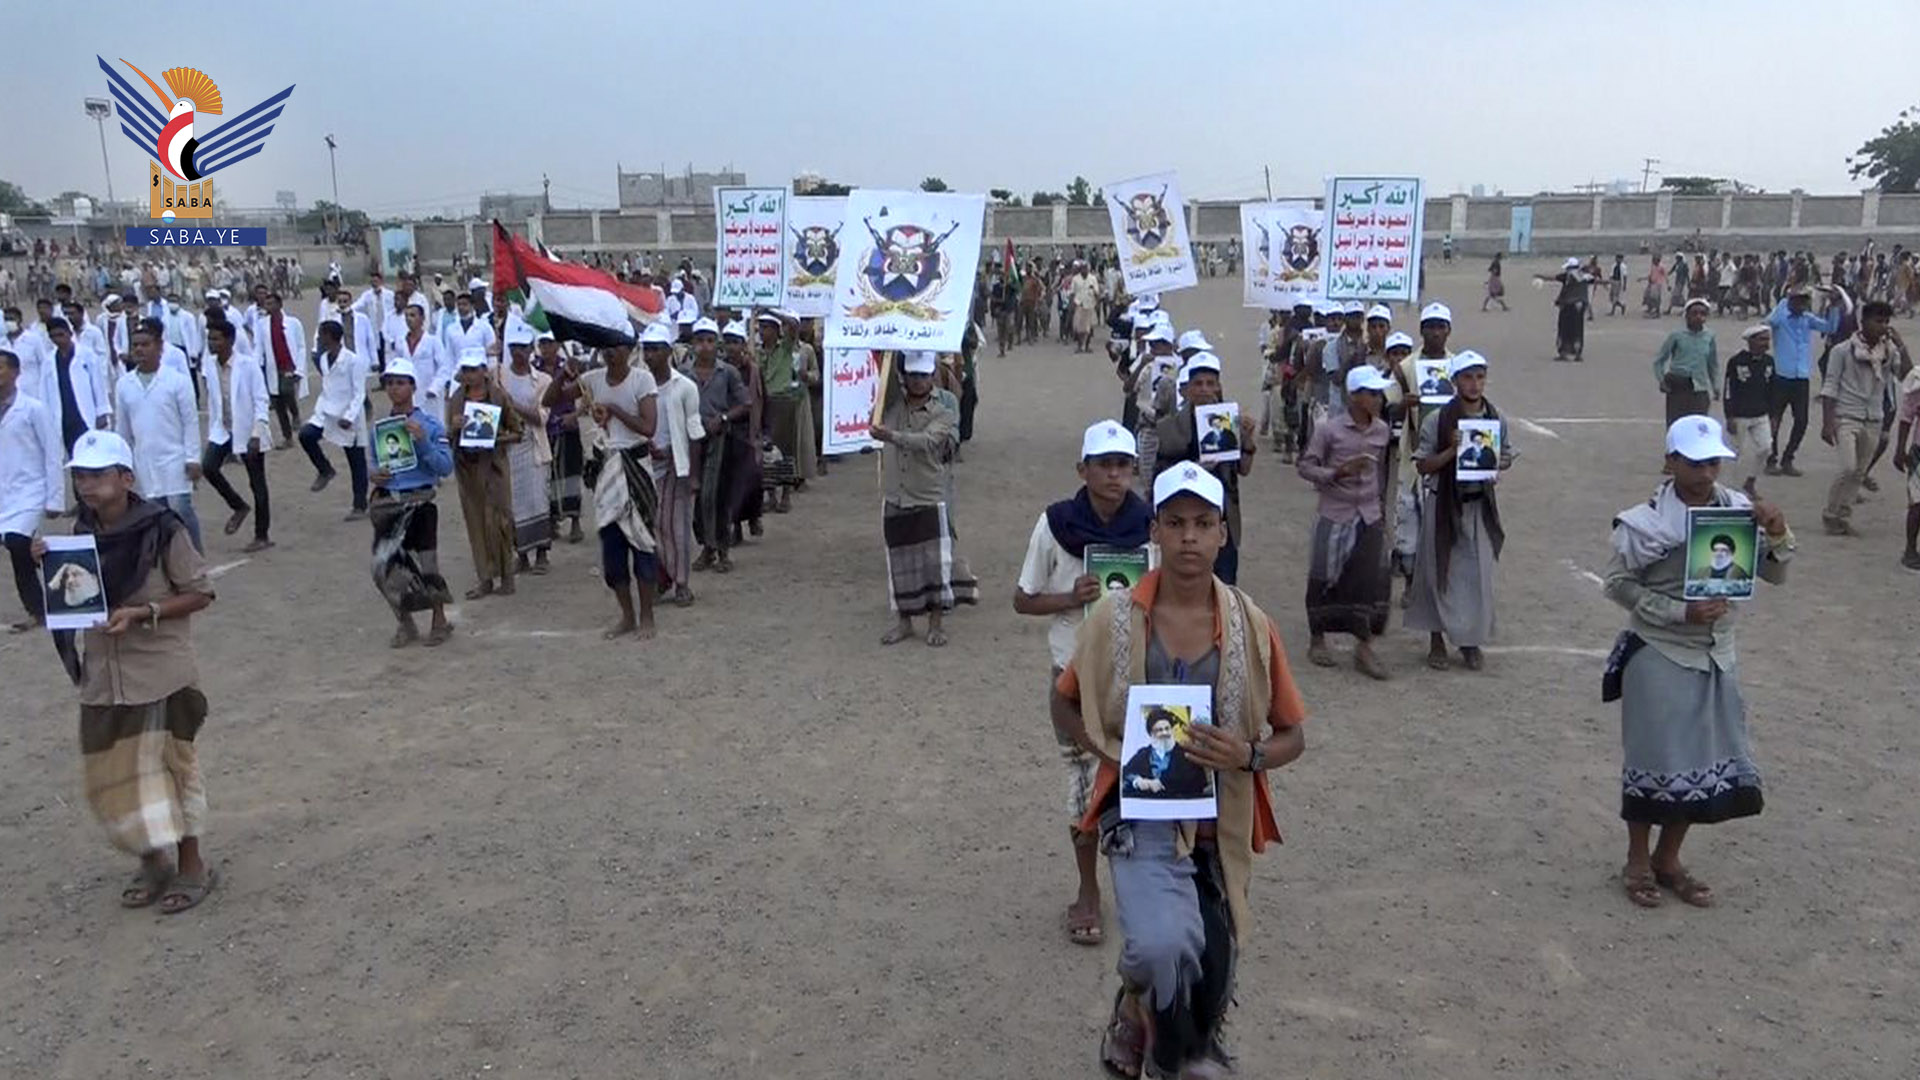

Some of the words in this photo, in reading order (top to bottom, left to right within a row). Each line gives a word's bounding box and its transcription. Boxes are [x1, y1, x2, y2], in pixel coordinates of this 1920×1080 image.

[759, 194, 782, 213] الله
[1337, 182, 1384, 210] أكبر
[1385, 185, 1415, 205] الله
[726, 192, 758, 219] أكبر
[1378, 213, 1412, 229] الموت
[1377, 234, 1411, 250] الموت
[1372, 272, 1408, 295] النصر
